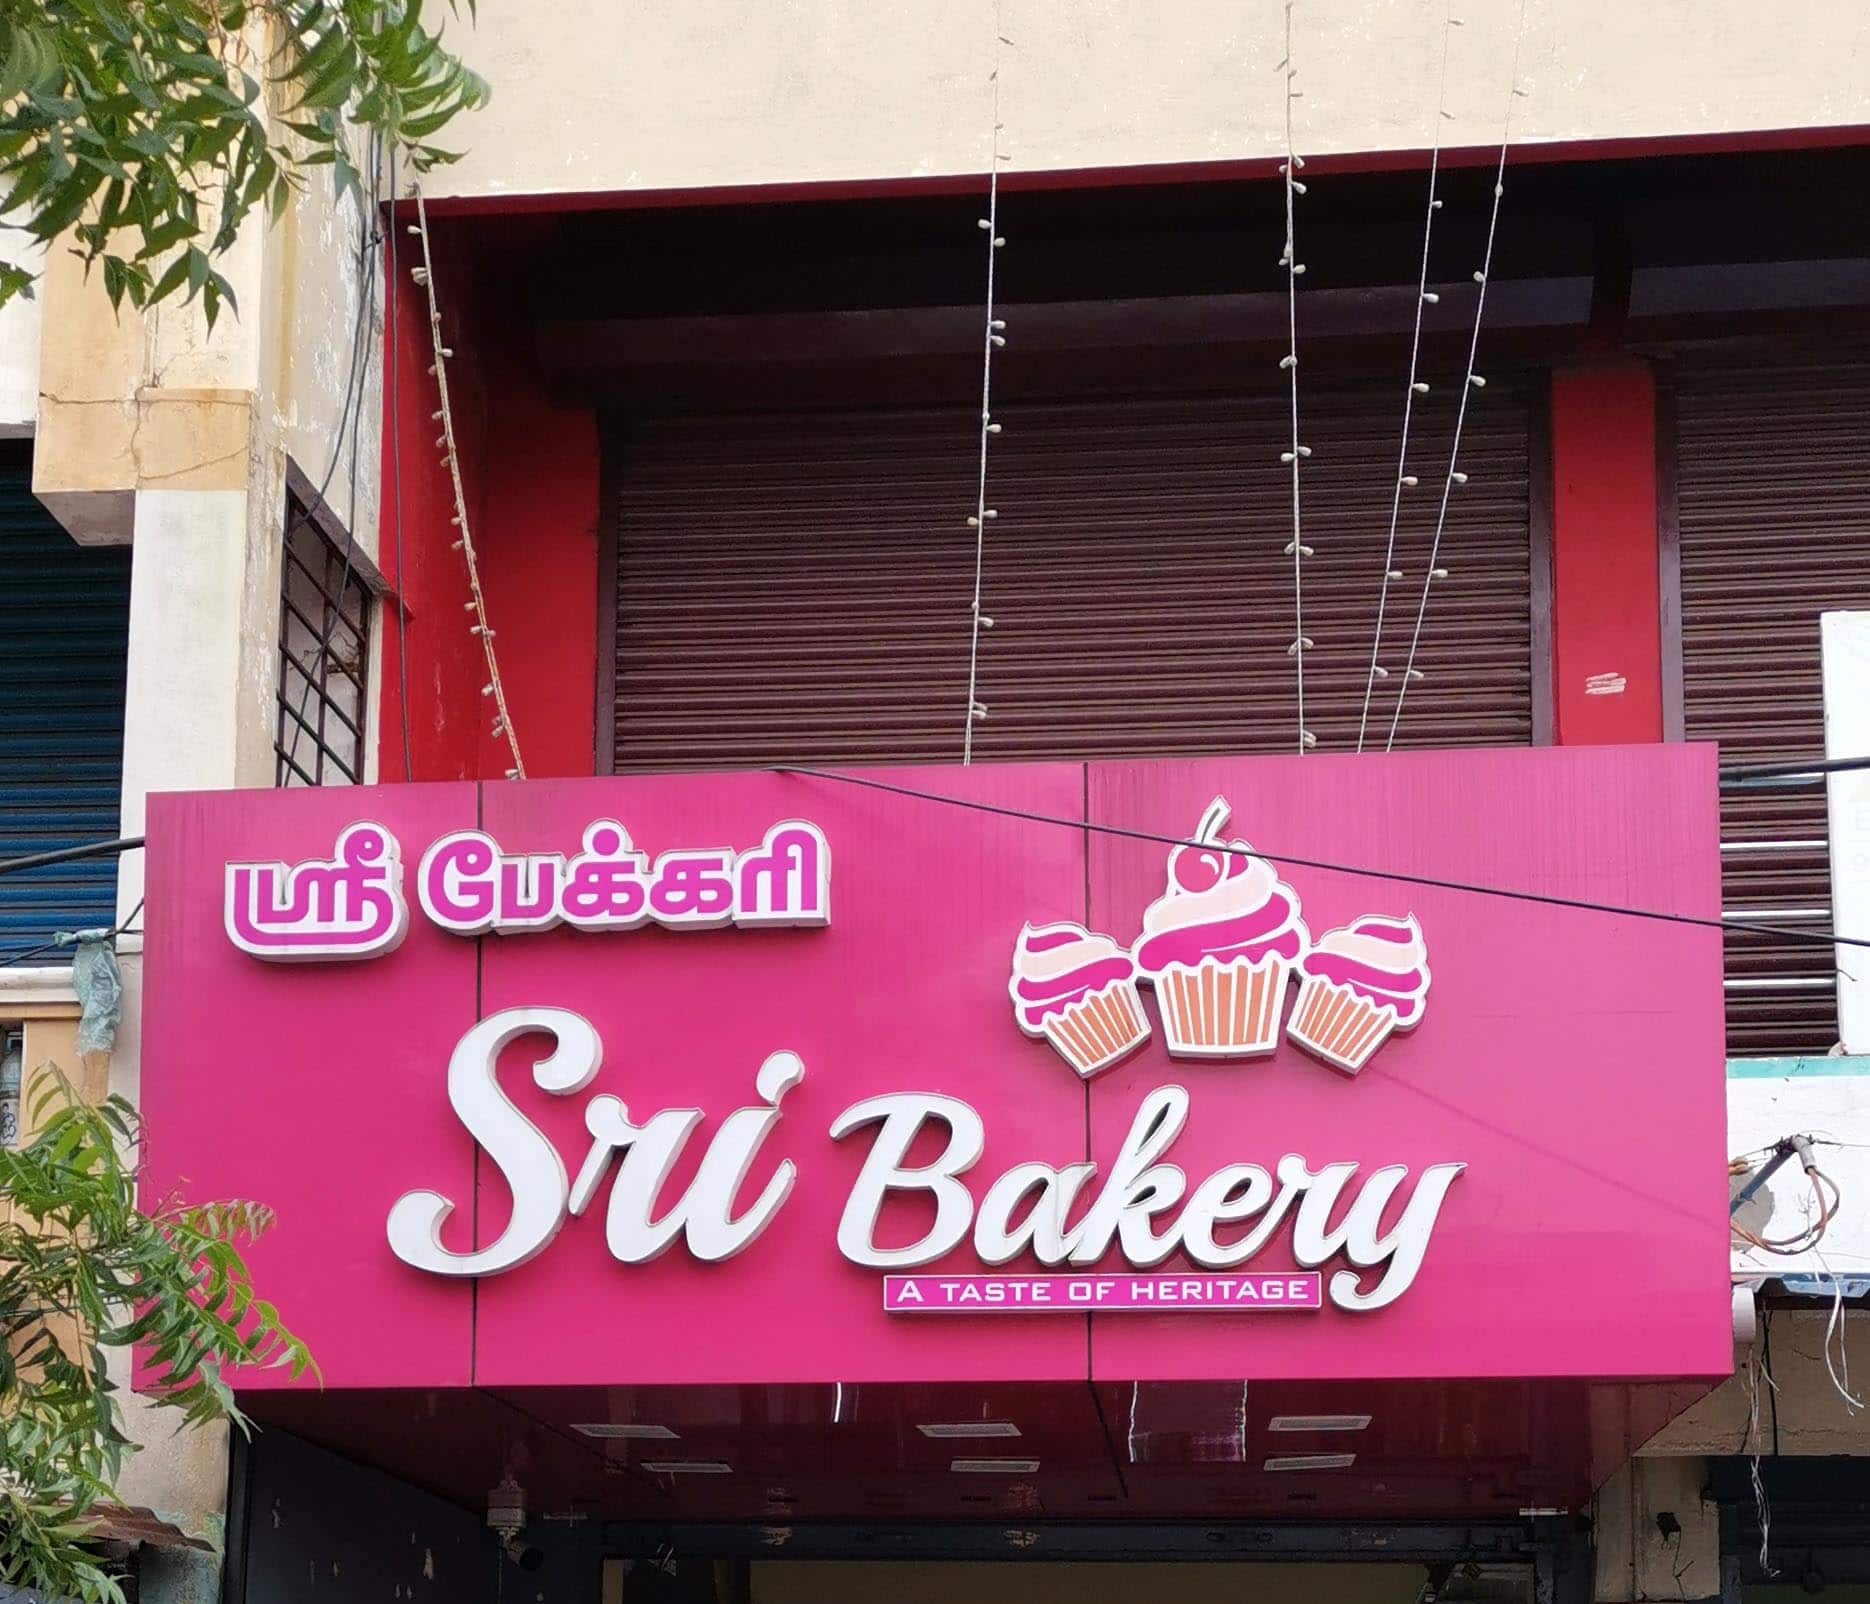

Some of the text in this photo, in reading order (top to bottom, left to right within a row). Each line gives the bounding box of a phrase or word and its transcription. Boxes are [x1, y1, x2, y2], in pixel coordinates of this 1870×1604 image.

[418, 818, 831, 935] பேக்கரி
[387, 1006, 1468, 1311] Sri Bakery
[896, 1279, 1309, 1302] A TASTE OF HERITAGE
